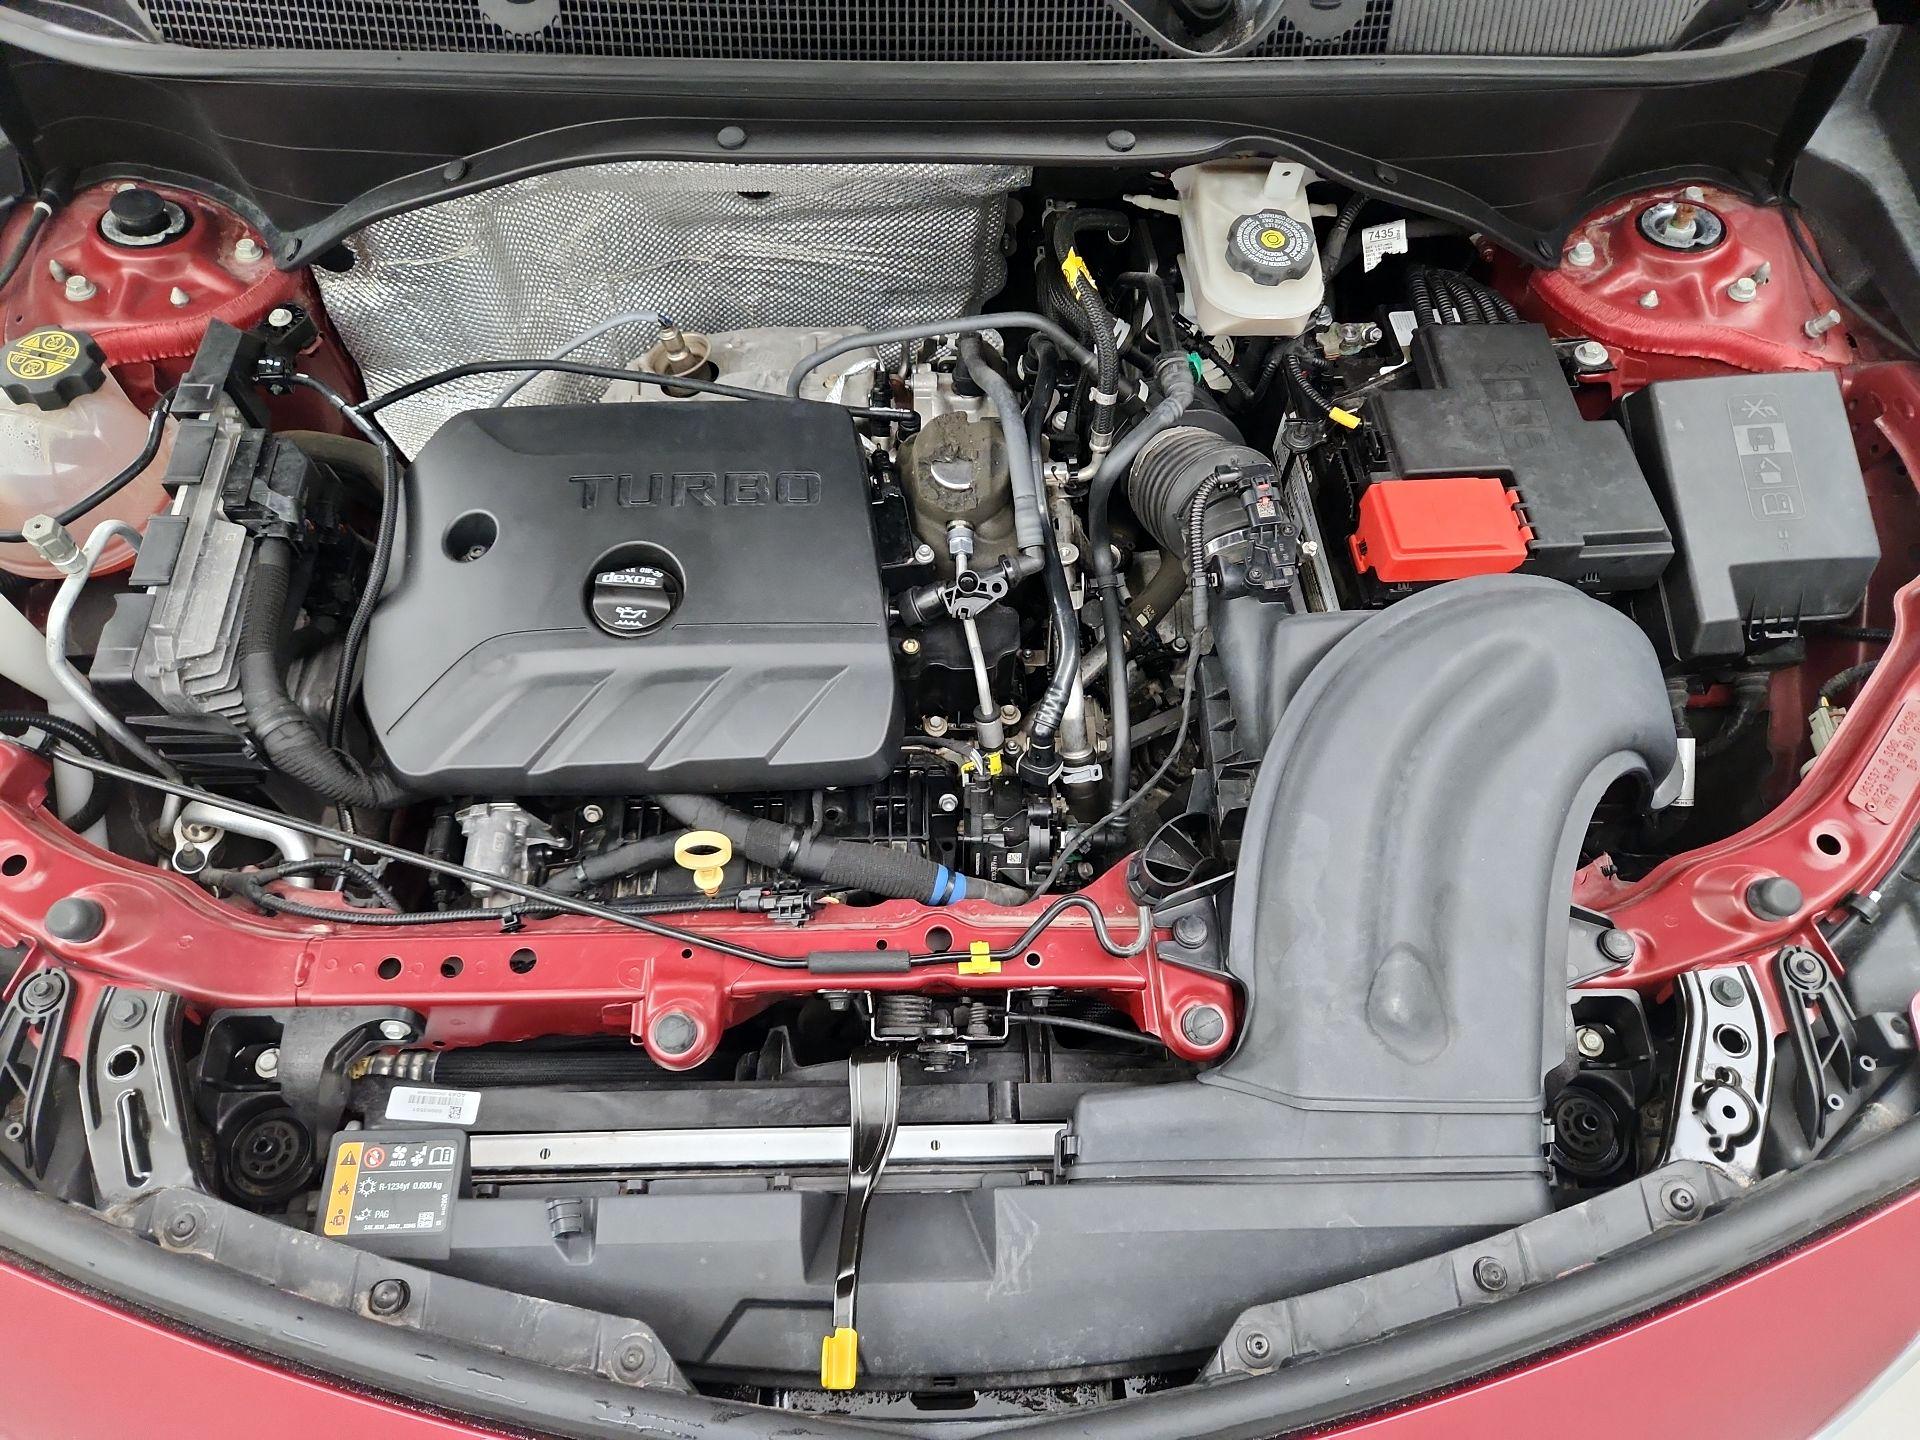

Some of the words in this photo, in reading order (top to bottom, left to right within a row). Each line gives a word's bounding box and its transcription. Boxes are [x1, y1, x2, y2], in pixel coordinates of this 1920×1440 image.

[1368, 227, 1394, 240] 7435
[569, 471, 822, 509] TURBO
[601, 572, 659, 586] dexos
[379, 1182, 410, 1191] R-1234yf
[412, 1182, 432, 1190] 0.600
[432, 1181, 443, 1191] kg
[374, 1209, 390, 1219] PAG
